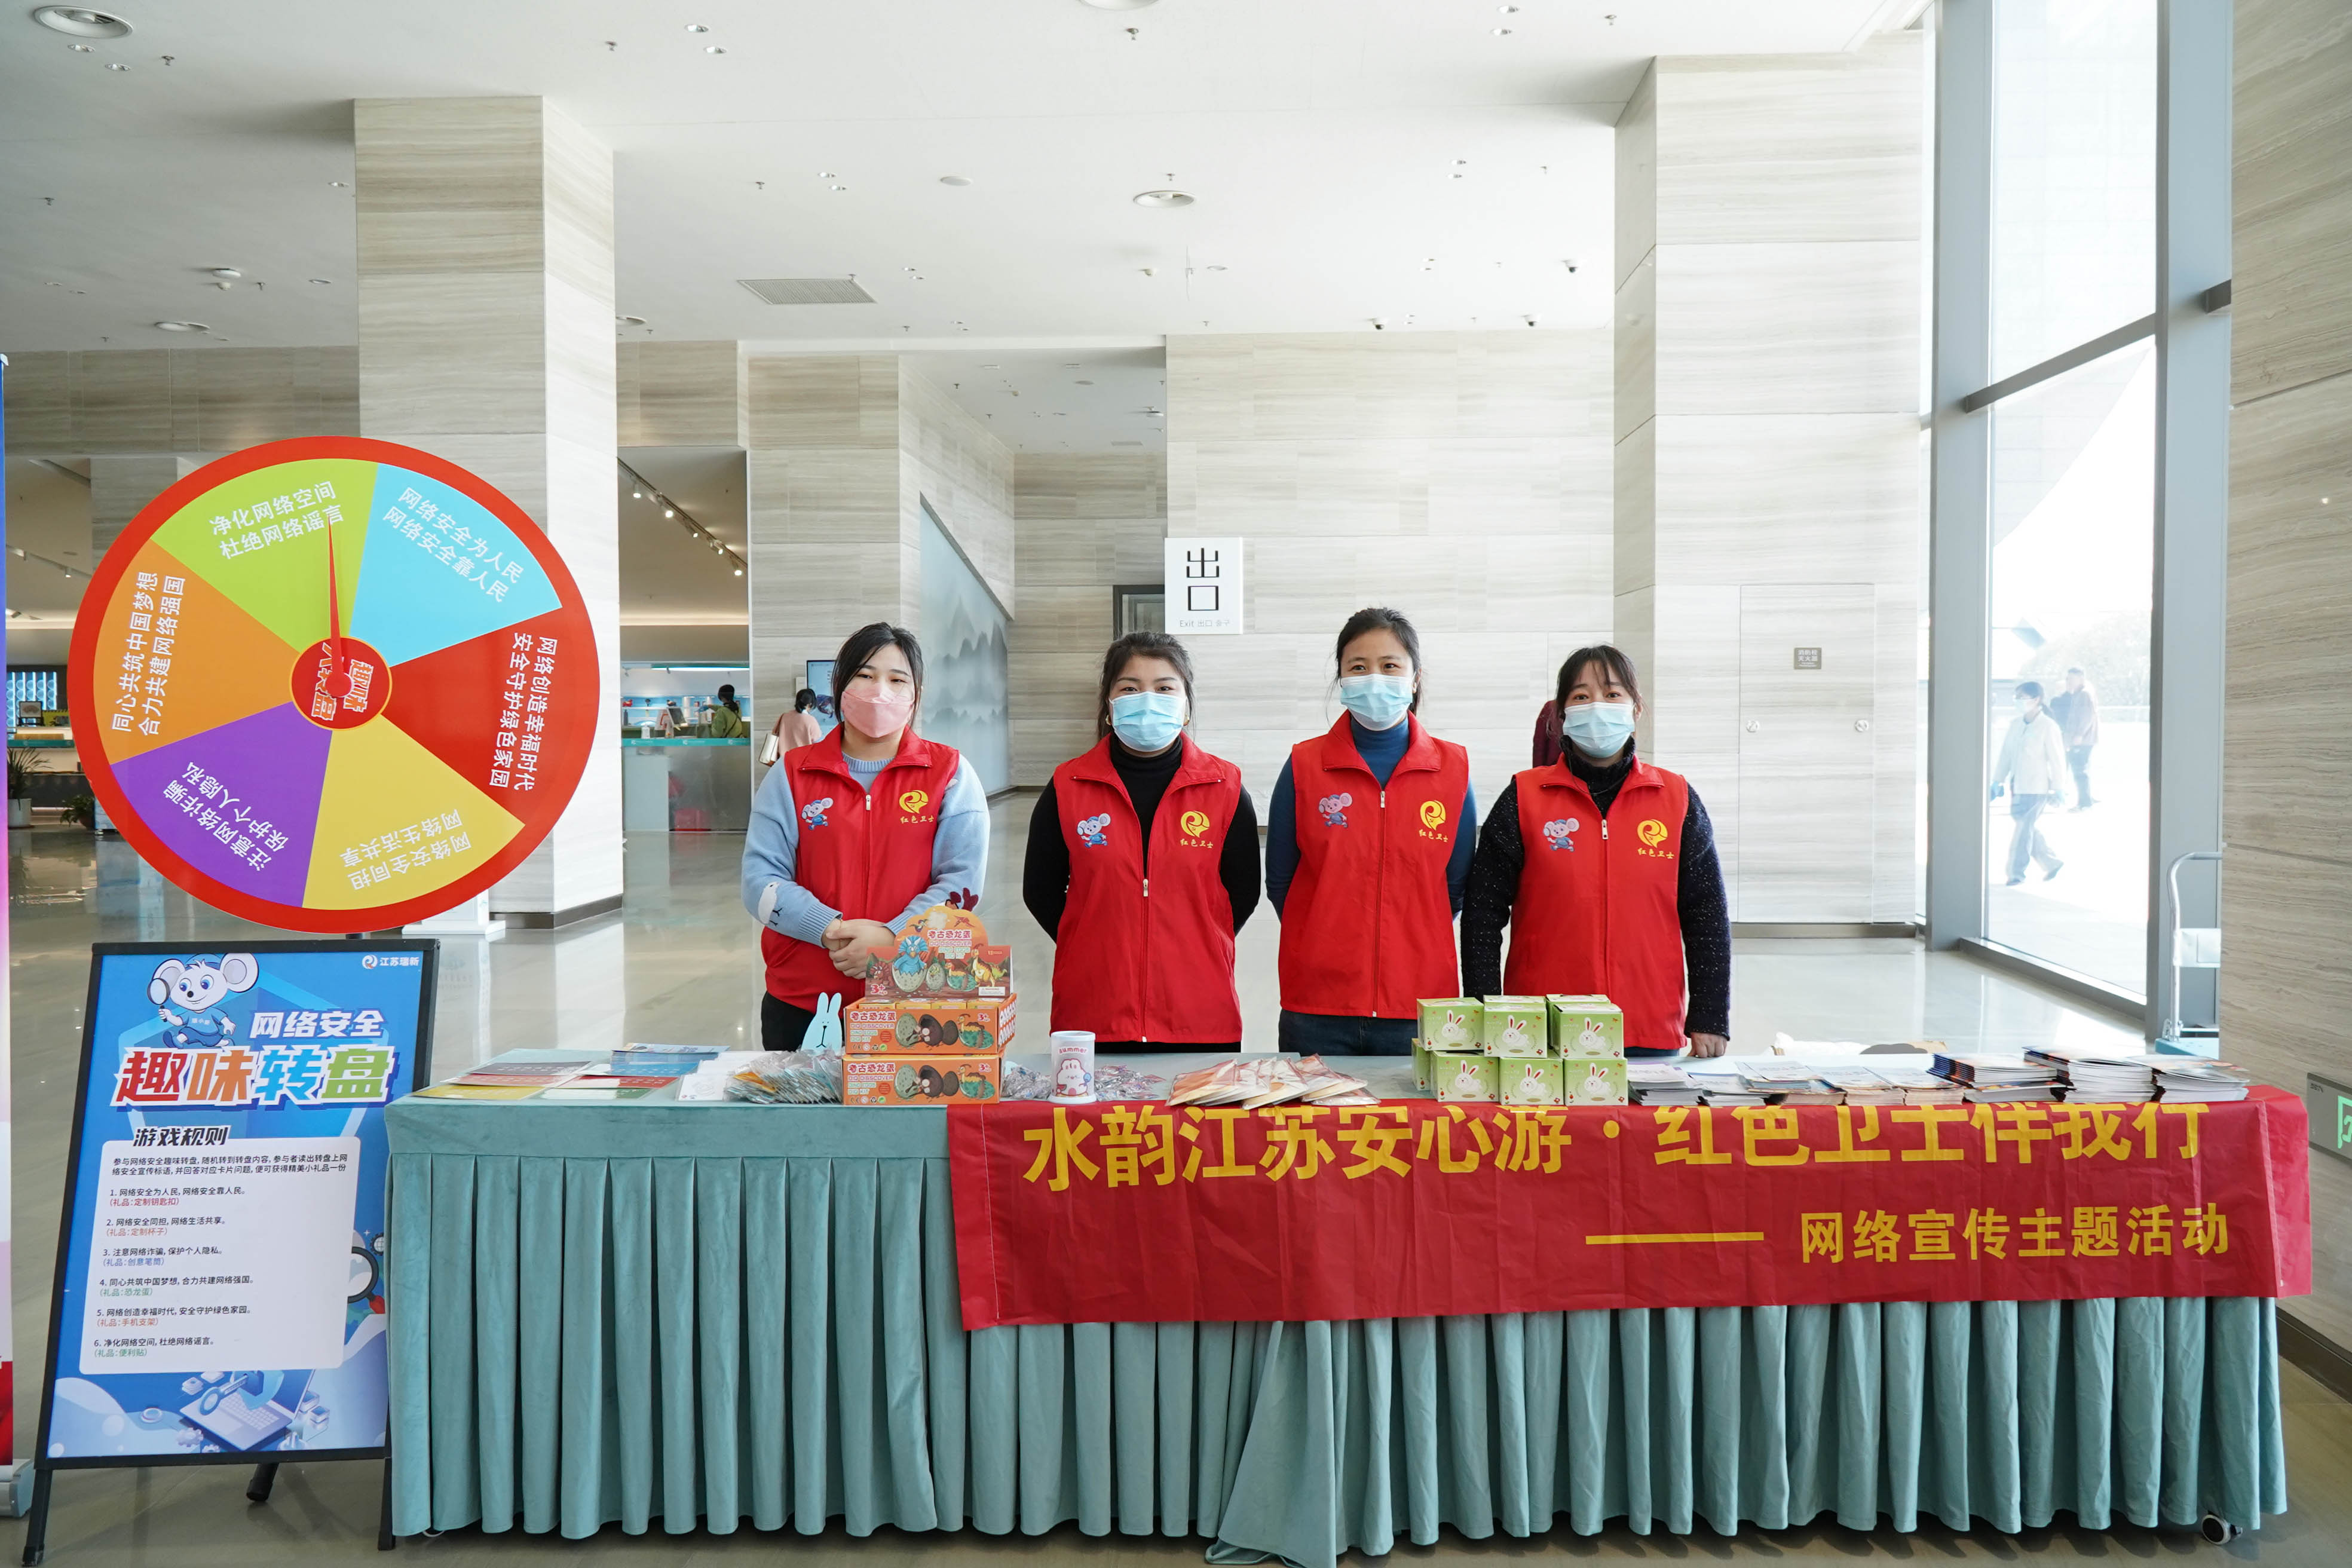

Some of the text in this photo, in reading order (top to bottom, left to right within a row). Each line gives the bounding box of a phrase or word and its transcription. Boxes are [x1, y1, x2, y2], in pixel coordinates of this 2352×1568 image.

[209, 481, 336, 538] 净化网络空间
[219, 504, 345, 559] 杜绝网络谣言
[398, 487, 525, 584] 网络安全为人民
[382, 507, 510, 603] 网络安全靠人民
[1186, 547, 1220, 611] 出口
[111, 572, 158, 732] 同心共筑中国梦想
[139, 576, 186, 736] 合力共建网络强国
[344, 659, 374, 712] 趣味
[490, 633, 534, 788] 安全守护绿色家园
[513, 636, 558, 791] 网络创造幸福时代
[164, 780, 272, 872] 注意网络诈骗
[182, 762, 289, 851] 保护个人隐私
[900, 816, 934, 824] 红色卫士
[340, 809, 464, 865] 网络生活共享
[350, 832, 472, 891] 网络安全同担
[1180, 838, 1214, 849] 红色卫士
[1419, 829, 1448, 843] 红色卫士
[1637, 848, 1674, 859] 红色卫士
[928, 930, 971, 939] 考古恐龙蛋
[250, 1010, 383, 1038] 网络安全
[851, 1012, 896, 1021] 考古恐龙蛋
[115, 1047, 392, 1105] 趣味转盘
[849, 1064, 895, 1073] 考古恐龙蛋
[133, 1126, 230, 1147] 游戏规则
